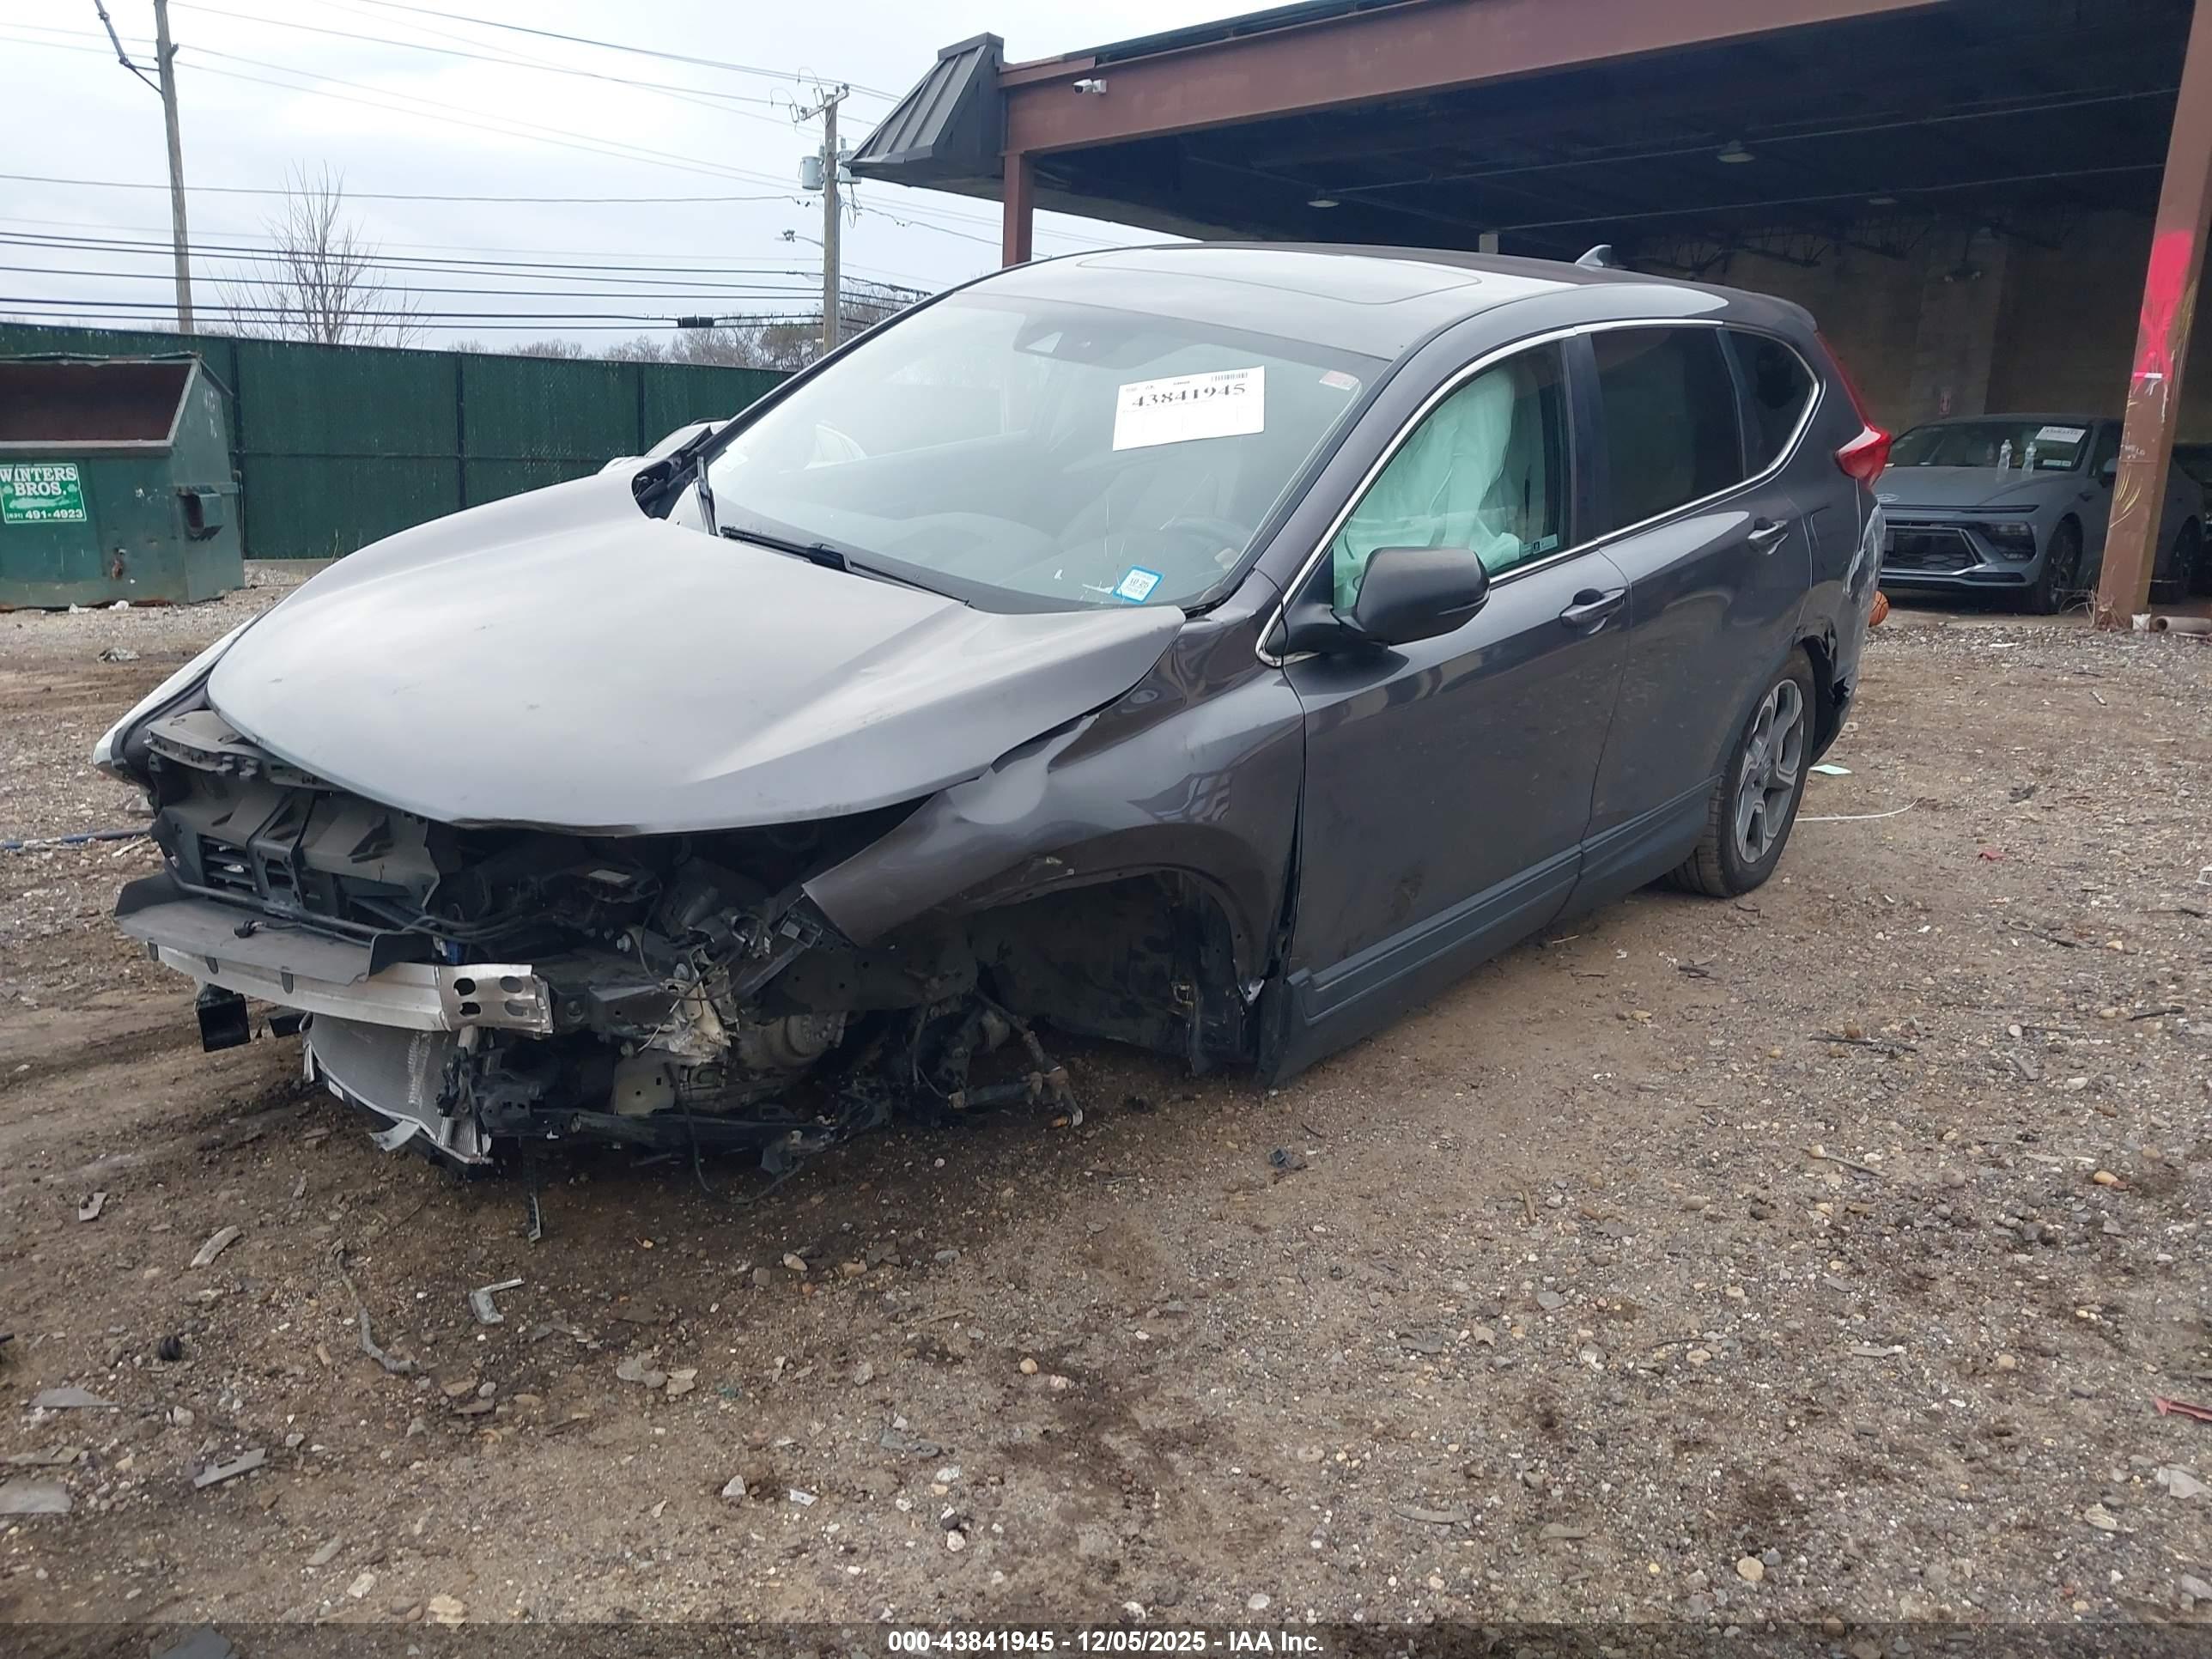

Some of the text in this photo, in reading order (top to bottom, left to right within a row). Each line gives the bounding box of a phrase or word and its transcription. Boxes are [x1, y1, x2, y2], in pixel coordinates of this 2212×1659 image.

[1132, 382, 1247, 407] 43841945
[0, 467, 77, 483] WINTERS
[14, 482, 67, 496] BROS.
